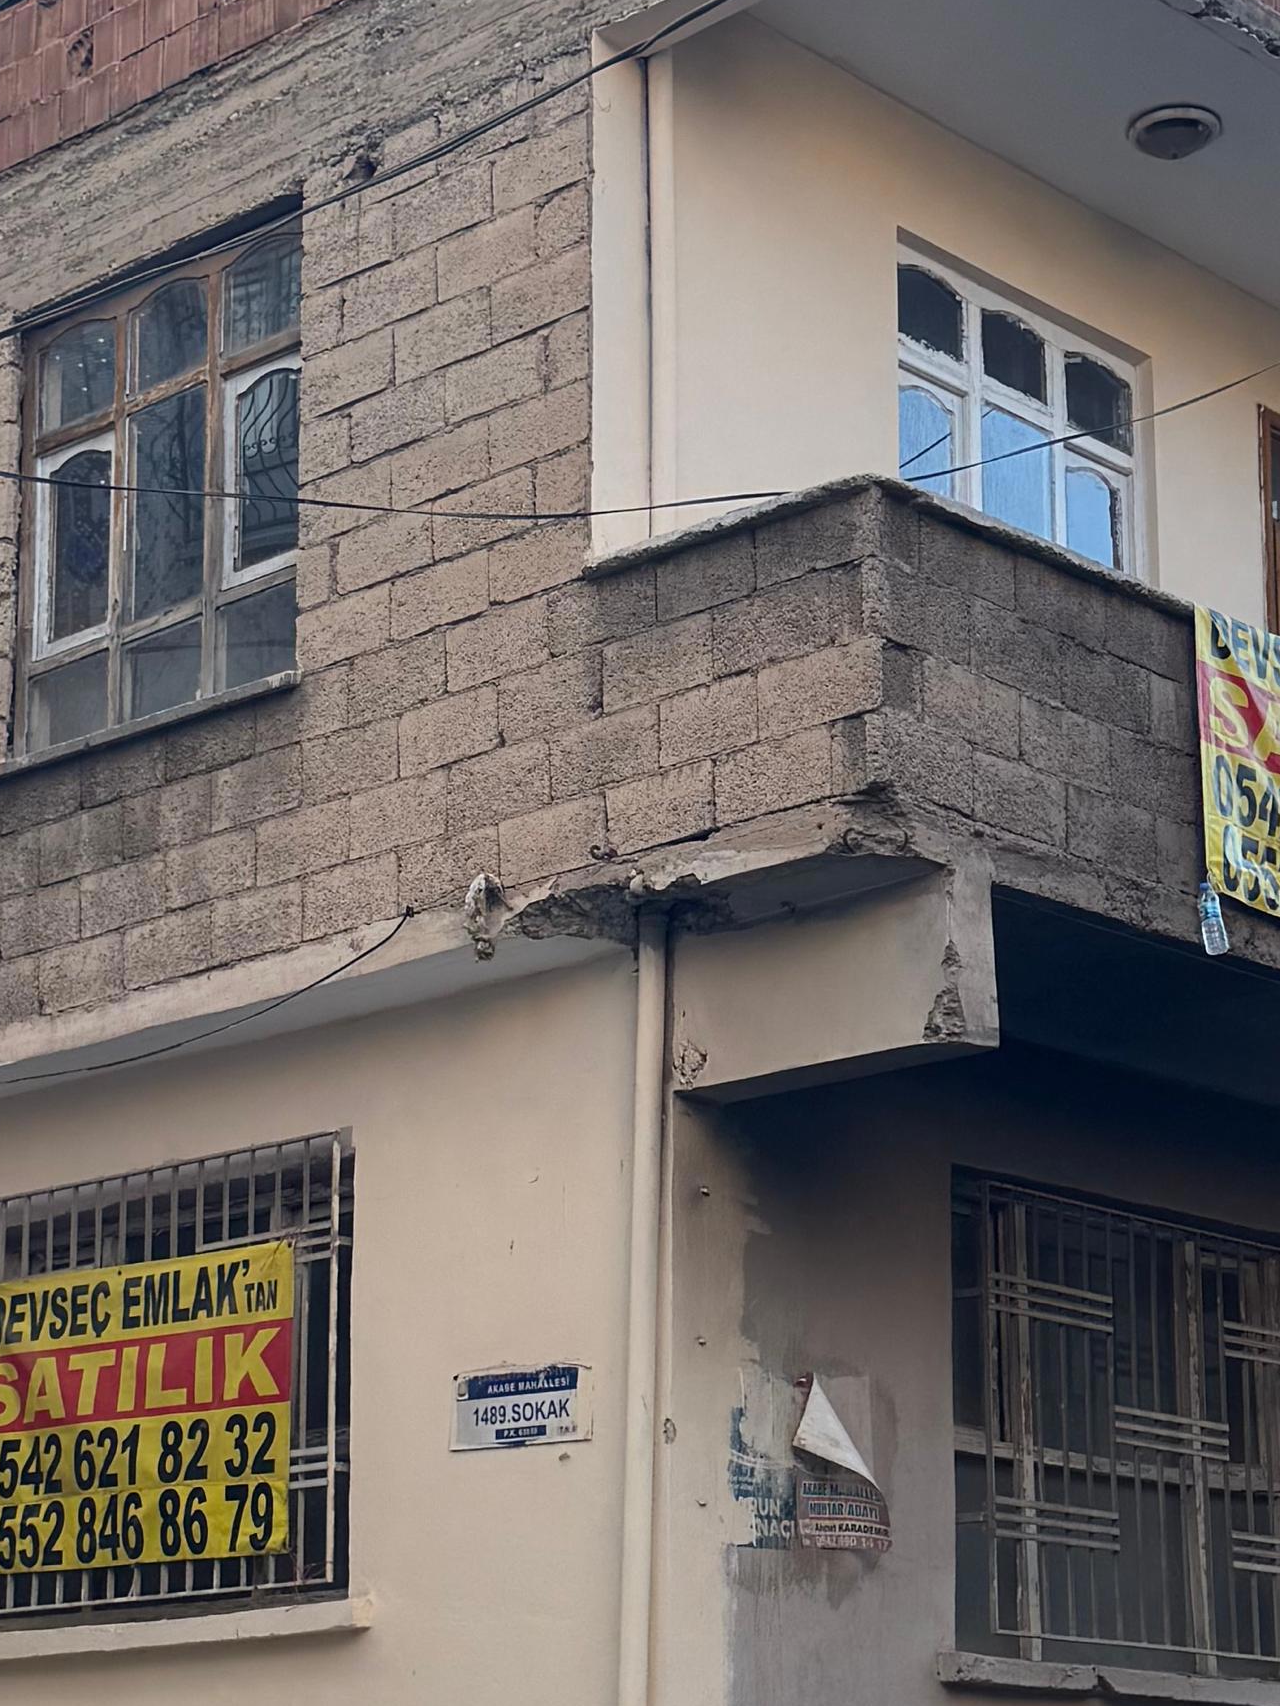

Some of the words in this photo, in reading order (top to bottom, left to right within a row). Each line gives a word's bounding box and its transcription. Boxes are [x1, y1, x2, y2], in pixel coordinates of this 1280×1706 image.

[74, 1424, 141, 1491] 621
[157, 1418, 210, 1484] 82
[224, 1411, 276, 1478] 32
[76, 1492, 144, 1564] 846
[159, 1487, 209, 1557] 86
[225, 1482, 274, 1552] 79
